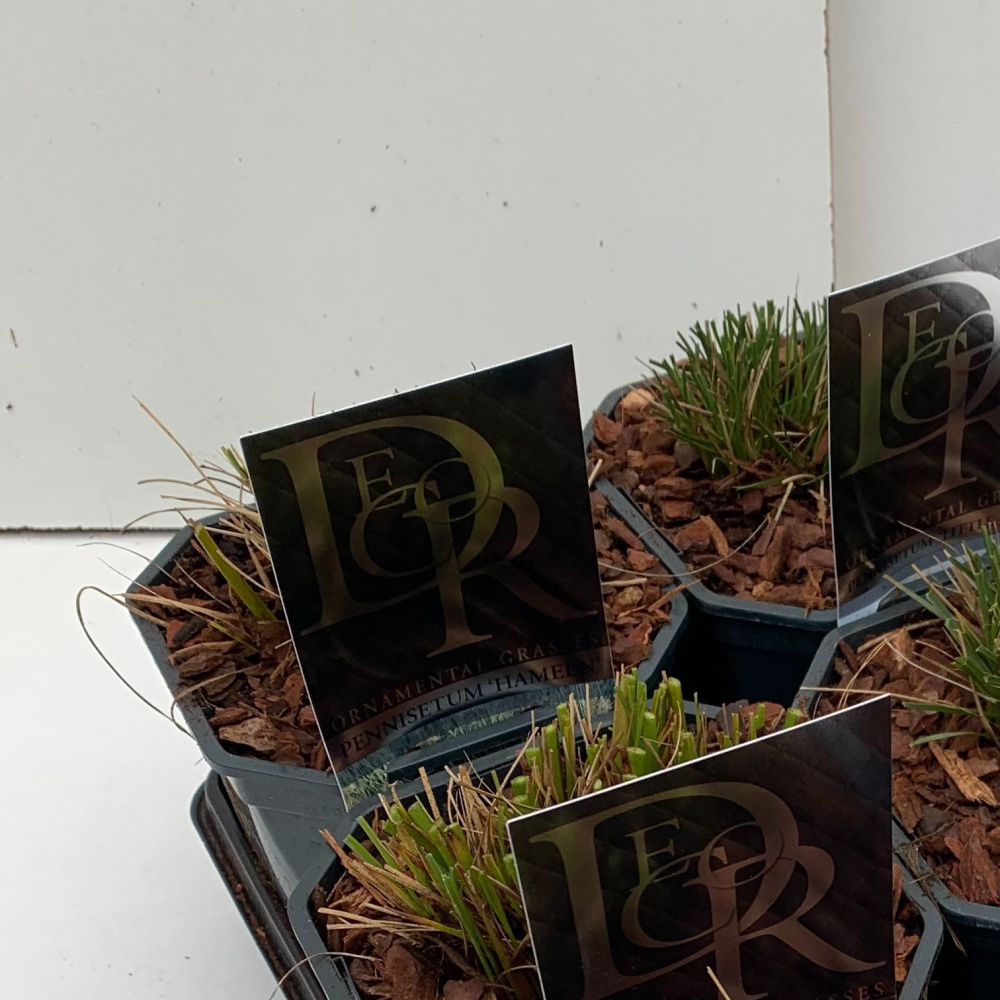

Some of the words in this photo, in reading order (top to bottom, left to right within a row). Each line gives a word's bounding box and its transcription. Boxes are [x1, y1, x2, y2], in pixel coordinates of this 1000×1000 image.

[332, 659, 488, 733] ORNAMENTAL
[499, 633, 599, 666] GRASES
[341, 683, 484, 758] PENNISETUM
